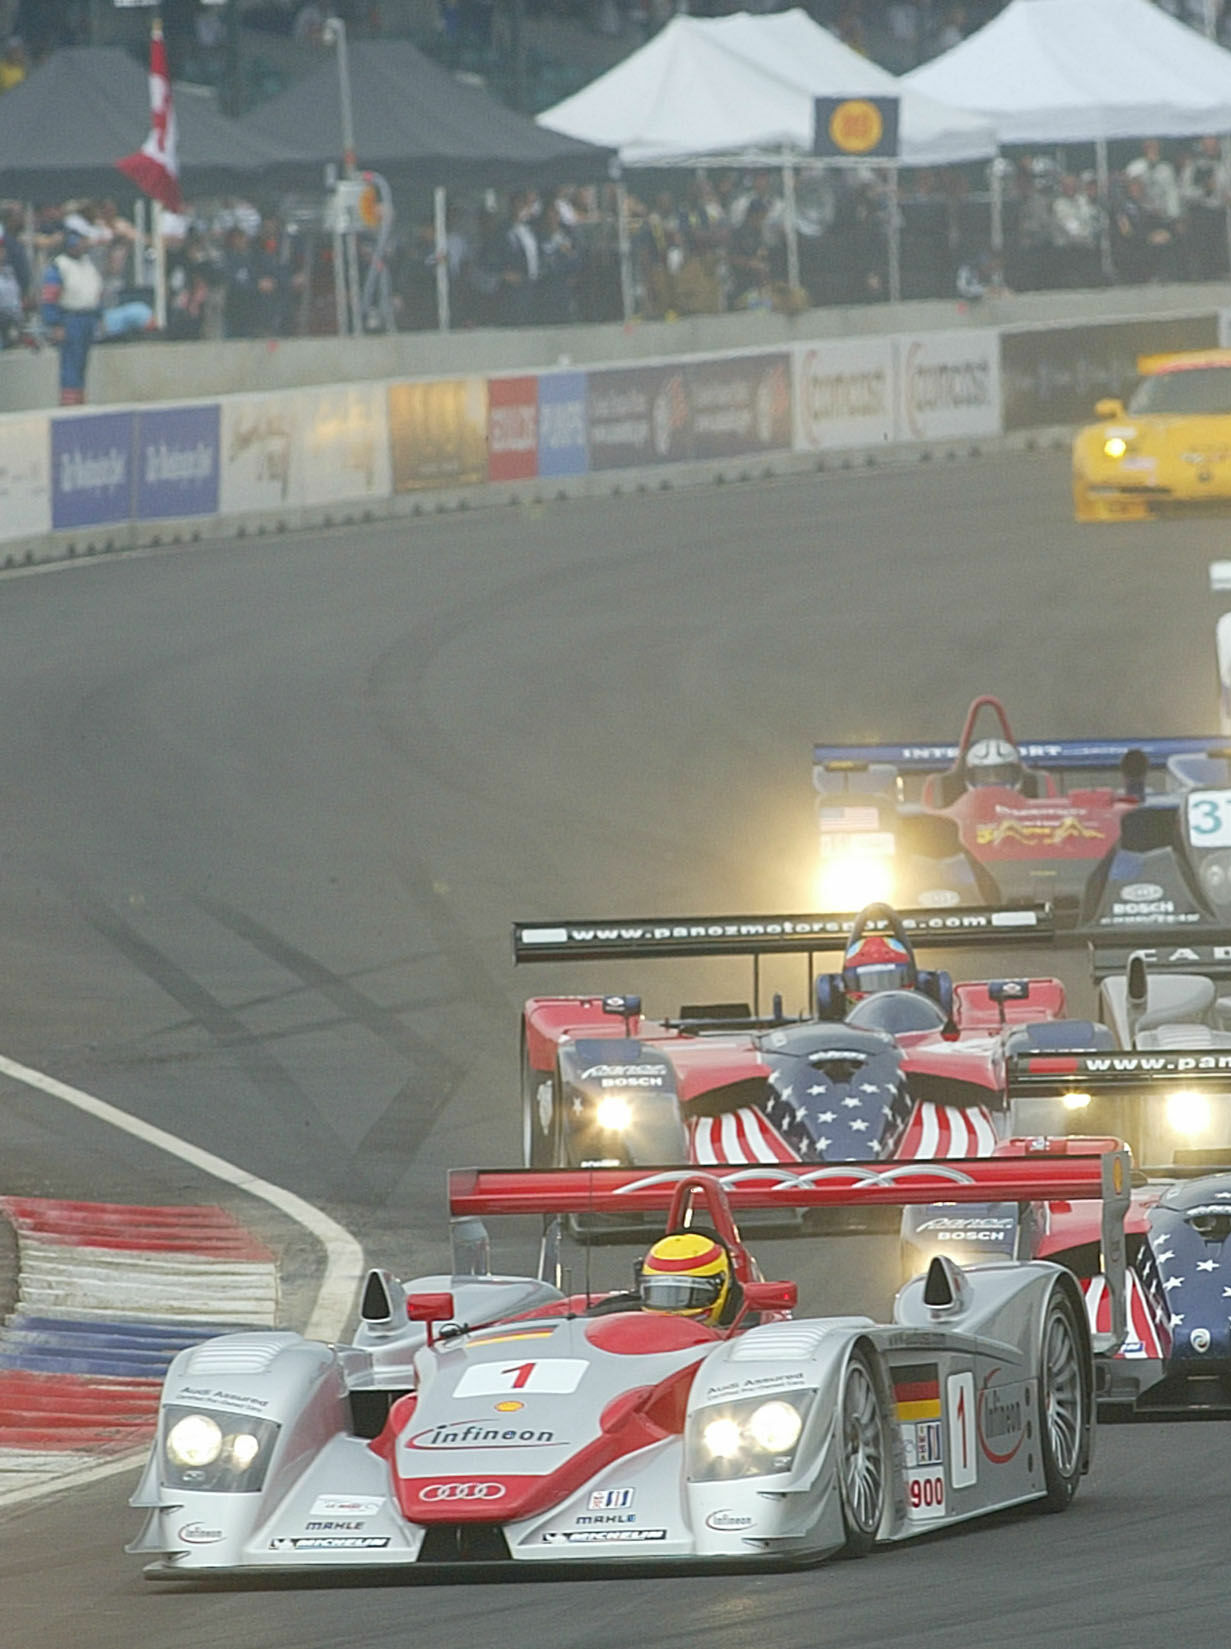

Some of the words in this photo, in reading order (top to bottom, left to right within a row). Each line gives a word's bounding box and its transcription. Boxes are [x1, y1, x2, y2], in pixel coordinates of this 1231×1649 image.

[1112, 901, 1175, 915] BOSCH
[571, 916, 988, 941] www.panozmotorspors.com
[601, 1076, 663, 1088] BOSCH
[937, 1231, 1005, 1241] BOSCH
[501, 1362, 537, 1389] 1
[956, 1385, 968, 1469] 1
[576, 1514, 637, 1525] MAHLE
[305, 1521, 366, 1531] MAHLE
[569, 1530, 665, 1542] MICHELIN
[296, 1537, 388, 1548] MICHELIN
